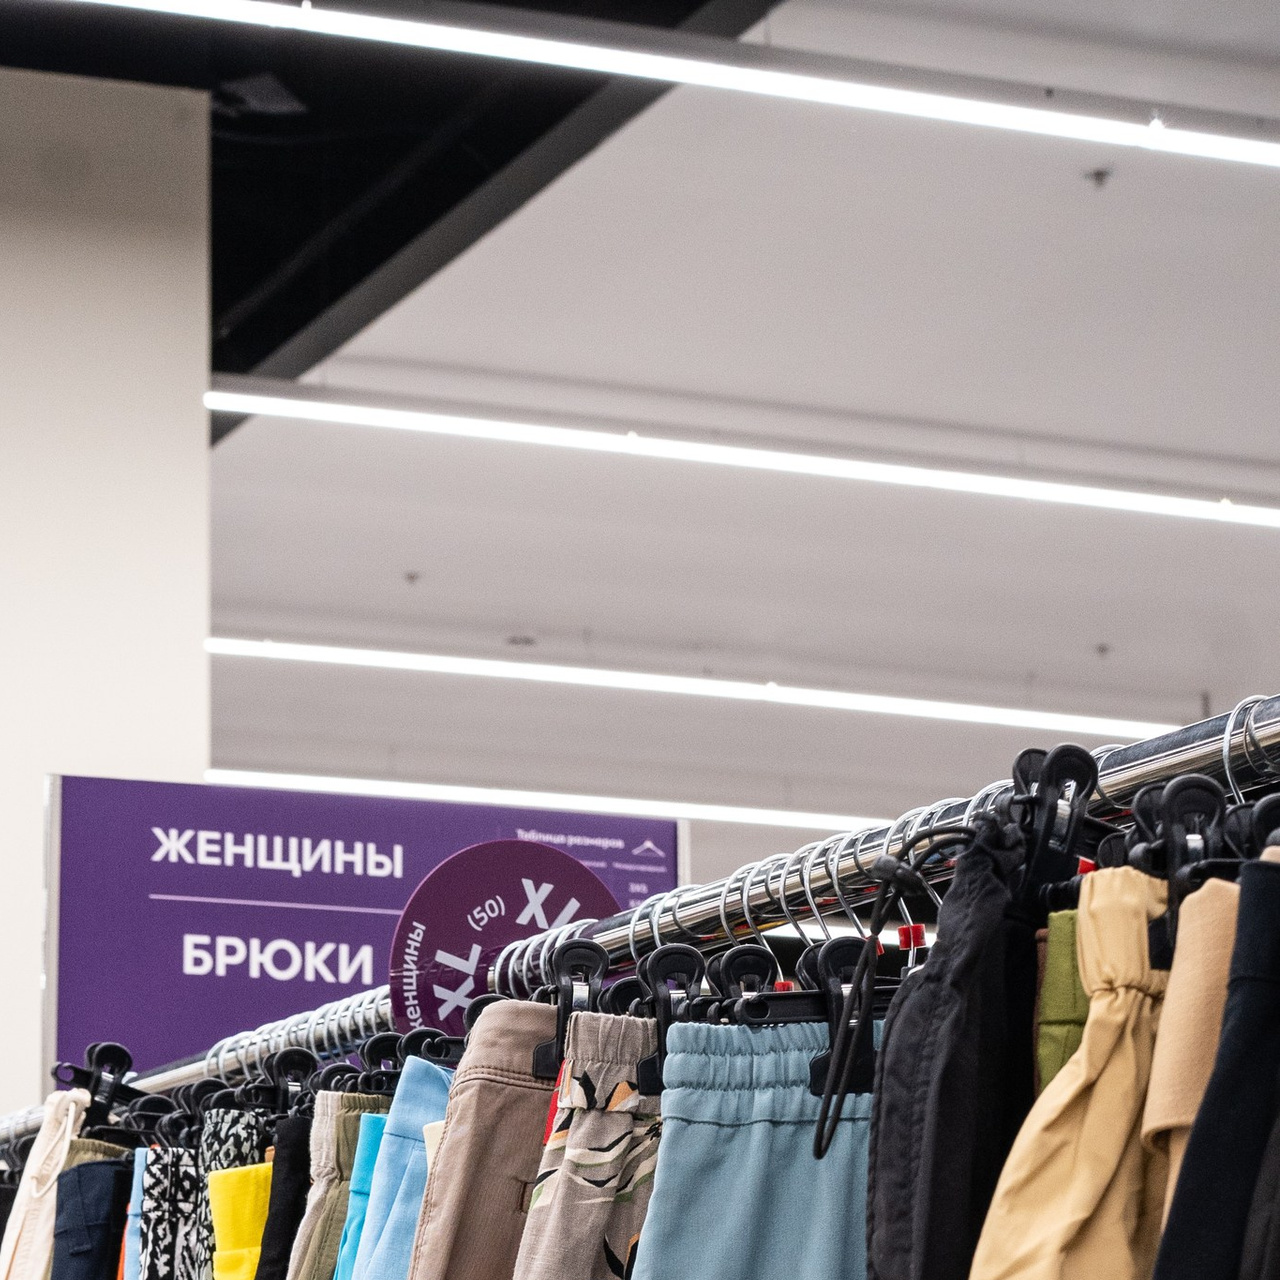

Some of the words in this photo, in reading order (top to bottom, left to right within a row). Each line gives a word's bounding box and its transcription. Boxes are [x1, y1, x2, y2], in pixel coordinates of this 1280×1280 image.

[151, 826, 404, 879] ЖЕНЩИНЫ
[467, 895, 505, 931] (50)
[182, 934, 374, 985] БРЮКИ
